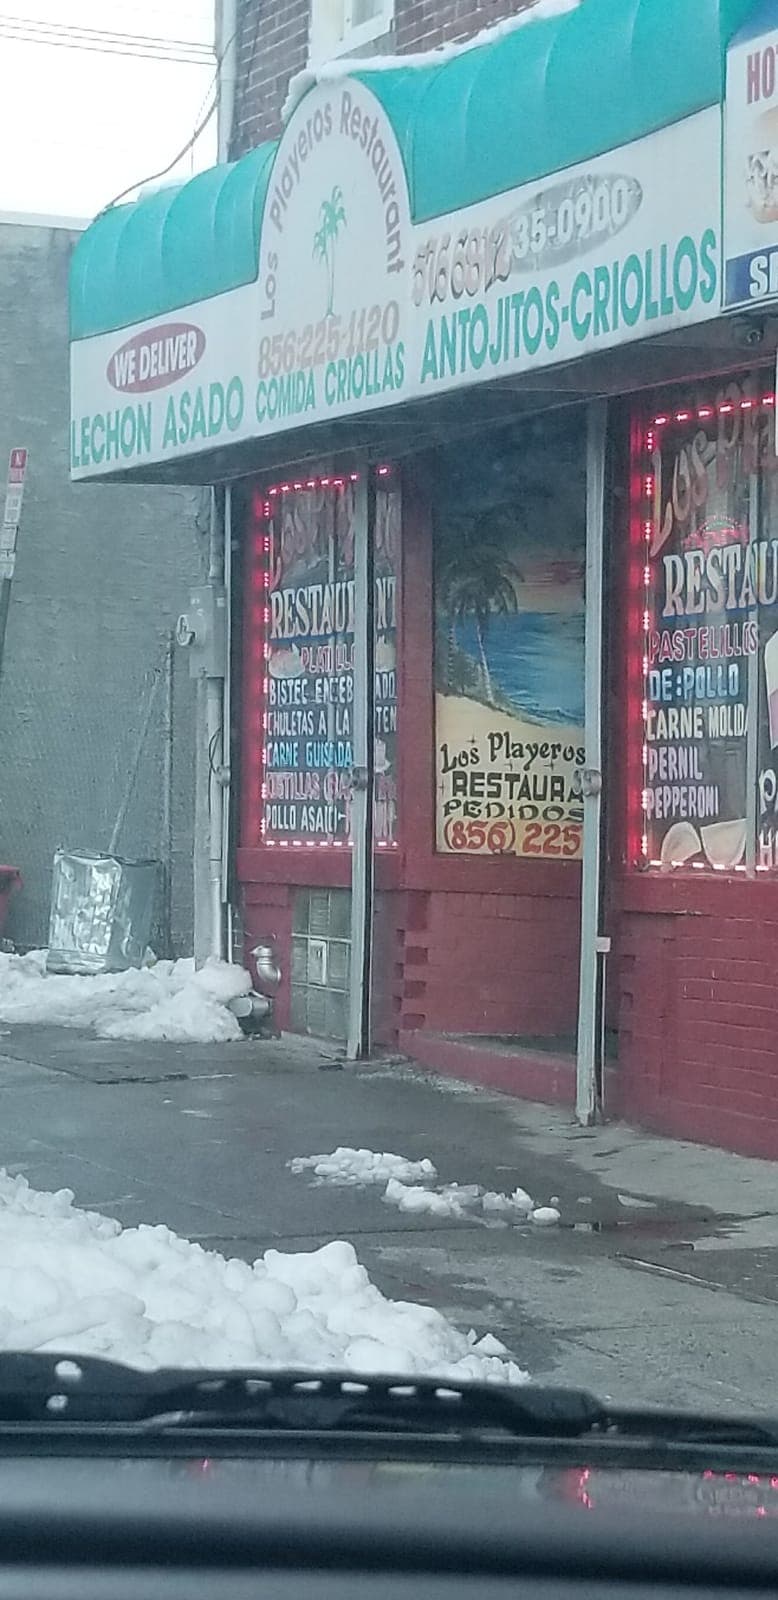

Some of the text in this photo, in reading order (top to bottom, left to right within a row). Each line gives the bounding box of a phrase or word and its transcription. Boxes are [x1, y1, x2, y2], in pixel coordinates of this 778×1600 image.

[746, 45, 778, 104] HO
[260, 90, 405, 320] Los Playeros Restaurant
[420, 228, 717, 384] ANTOJITOS-CRIOLLOS
[113, 329, 199, 388] WE DELIVER
[256, 341, 405, 423] COMIDA CRIOLLAS
[71, 402, 152, 468] LECHON
[162, 375, 245, 450] ASADO
[648, 620, 759, 664] PASTELILLOS
[269, 679, 308, 706] BISTEC
[267, 708, 350, 737] CHULETAS A LA
[646, 706, 704, 742] CARNE
[266, 742, 299, 768] CARNE
[440, 730, 587, 774] Los Playeros
[648, 746, 703, 781] PERNIL
[265, 804, 297, 830] POLLO
[443, 798, 585, 823] PEDIDOS
[646, 785, 720, 821] PEPPERONI
[443, 818, 516, 856] (856)
